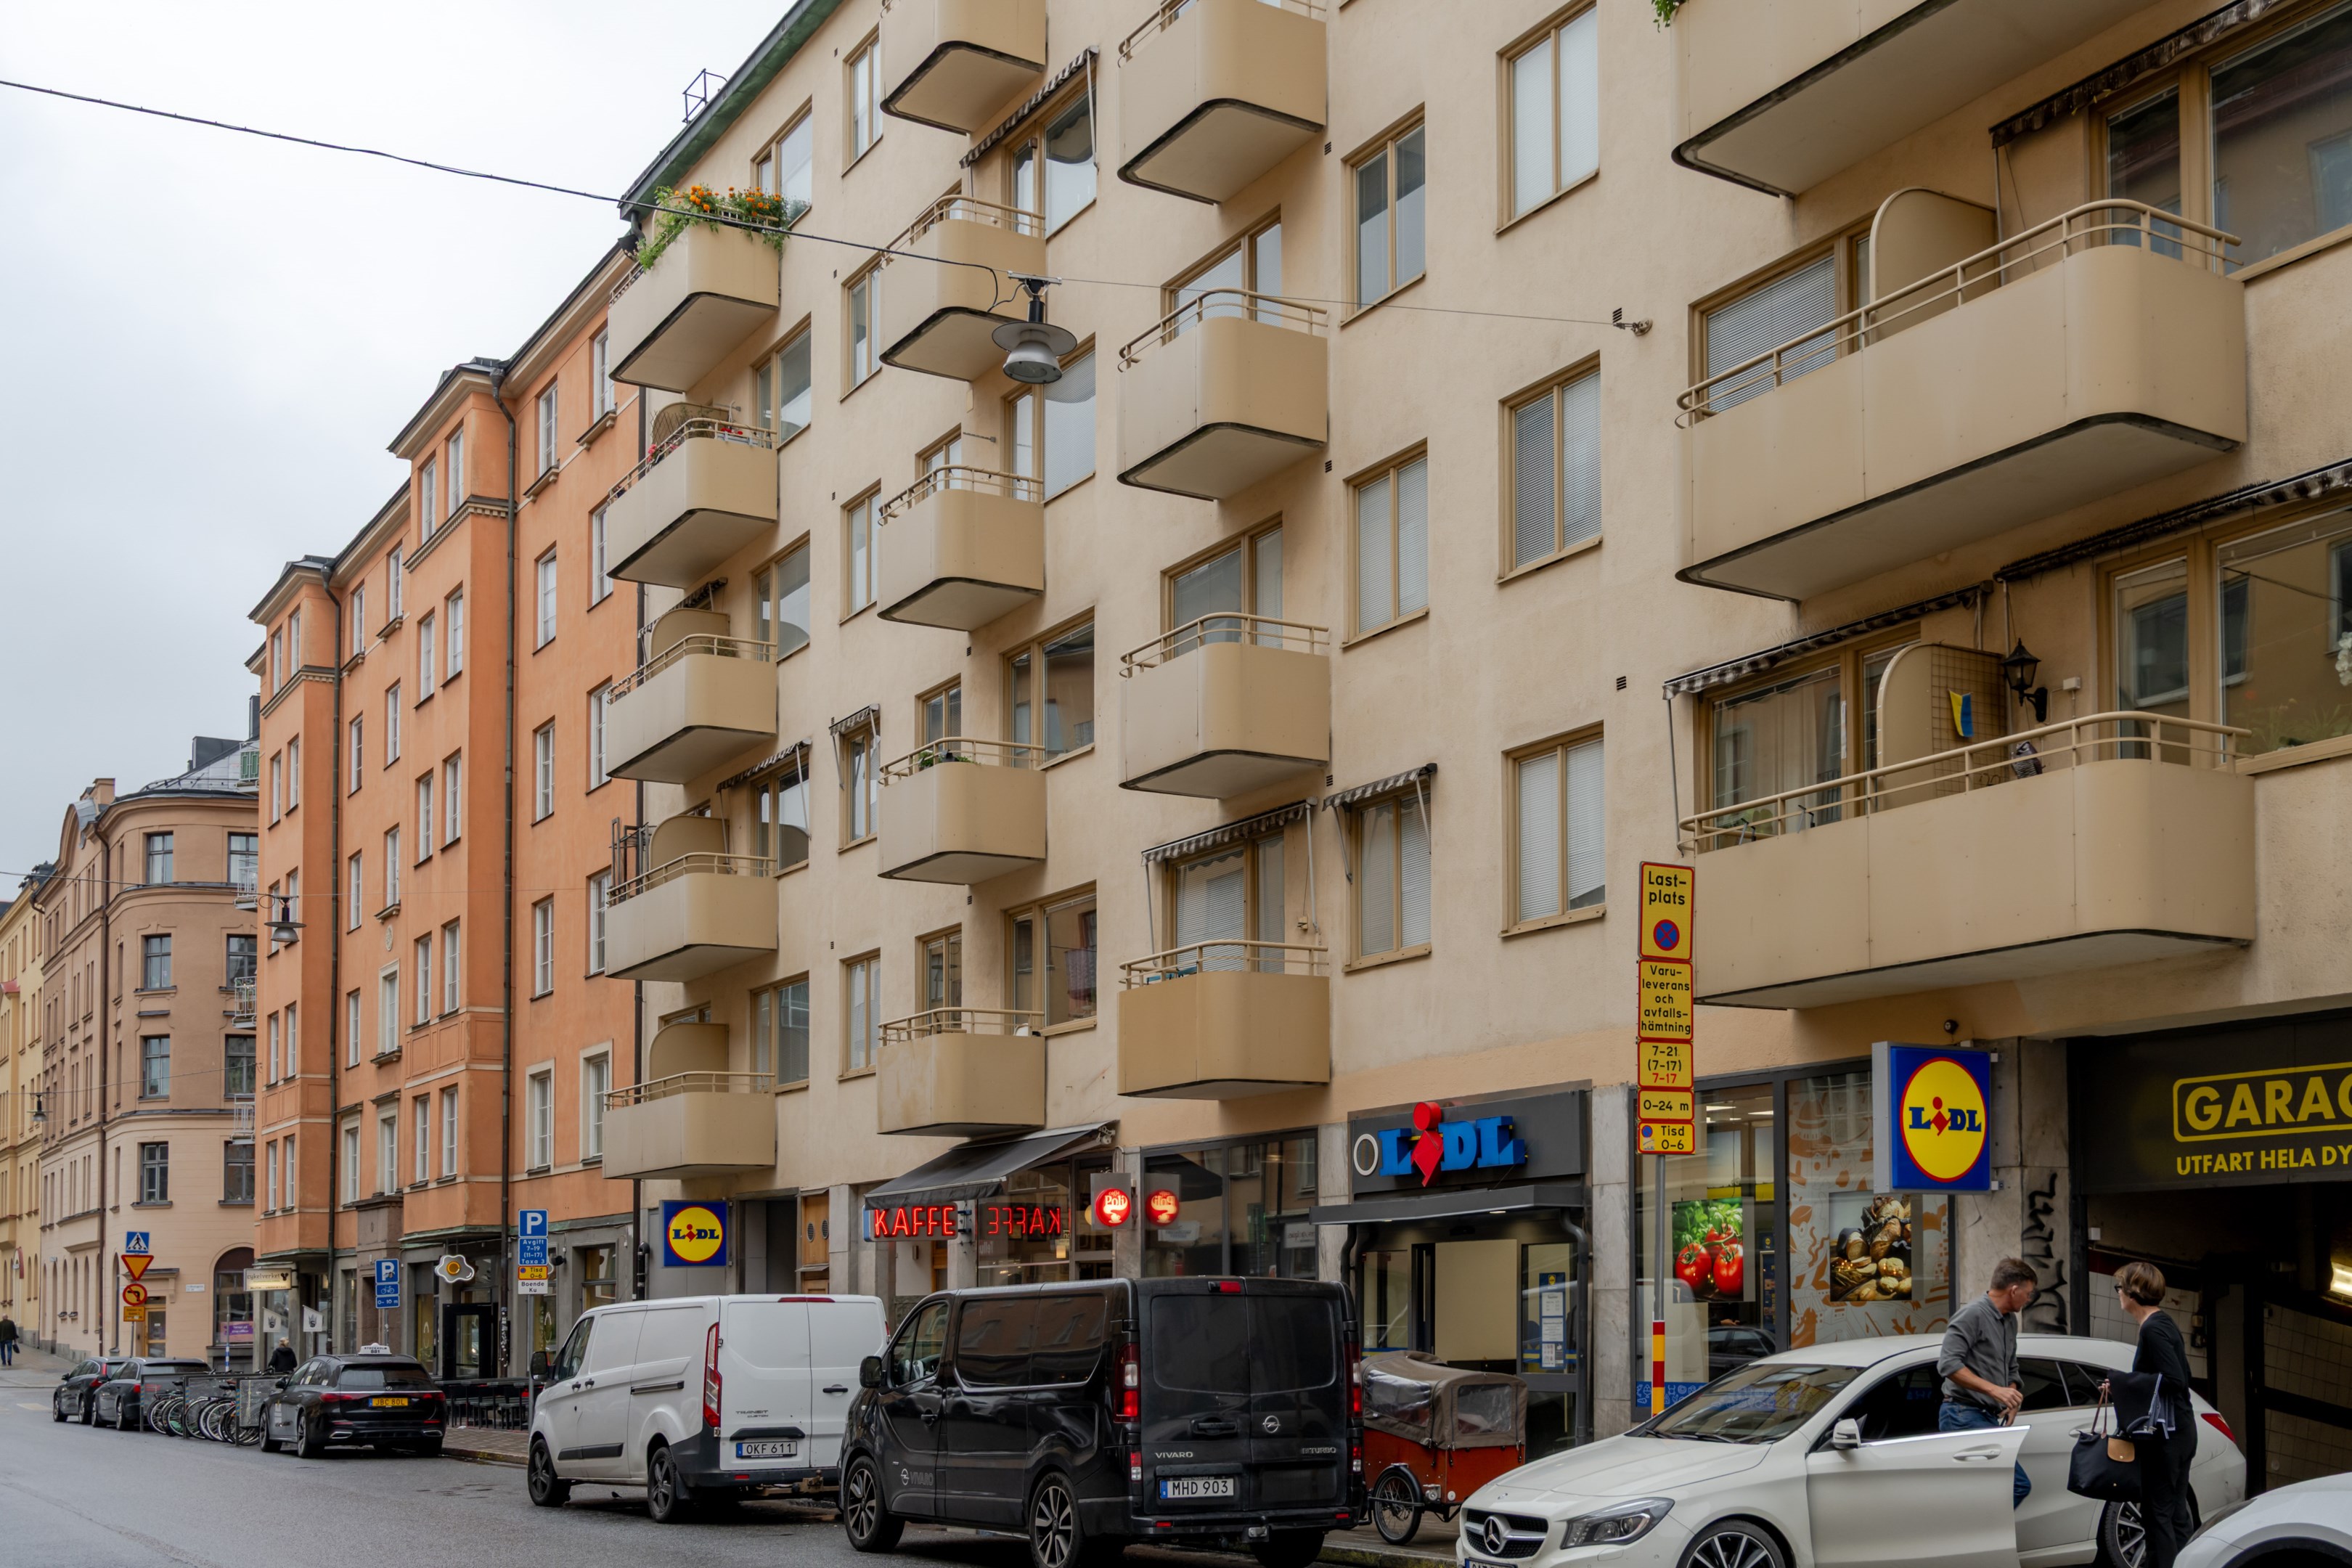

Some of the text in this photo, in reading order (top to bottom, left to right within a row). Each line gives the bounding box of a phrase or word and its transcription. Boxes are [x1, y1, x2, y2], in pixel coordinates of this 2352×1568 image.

[1649, 870, 1686, 887] Last-
[1649, 889, 1686, 905] plats
[1650, 965, 1682, 976] Varu-
[1642, 978, 1690, 991] leverans
[1655, 994, 1674, 1004] och
[1644, 1007, 1689, 1018] avfalls-
[1641, 1020, 1691, 1035] hämtning
[1652, 1045, 1678, 1057] 7-21
[1647, 1058, 1682, 1072] (7-17)
[1652, 1072, 1677, 1084] 7-17
[1643, 1099, 1689, 1111] 0-24 m
[1661, 1125, 1685, 1136] Tisd
[1661, 1139, 1684, 1150] 0-6
[2176, 1151, 2254, 1175] UTFART
[2260, 1147, 2316, 1169] HELA
[1104, 1195, 1124, 1206] Poli
[526, 1212, 543, 1234] P
[873, 1206, 956, 1238] KAFFE
[381, 1262, 395, 1281] P
[746, 1443, 791, 1454] OKF 611
[910, 1471, 934, 1486] VIVARO
[1172, 1480, 1228, 1496] MHD 903
